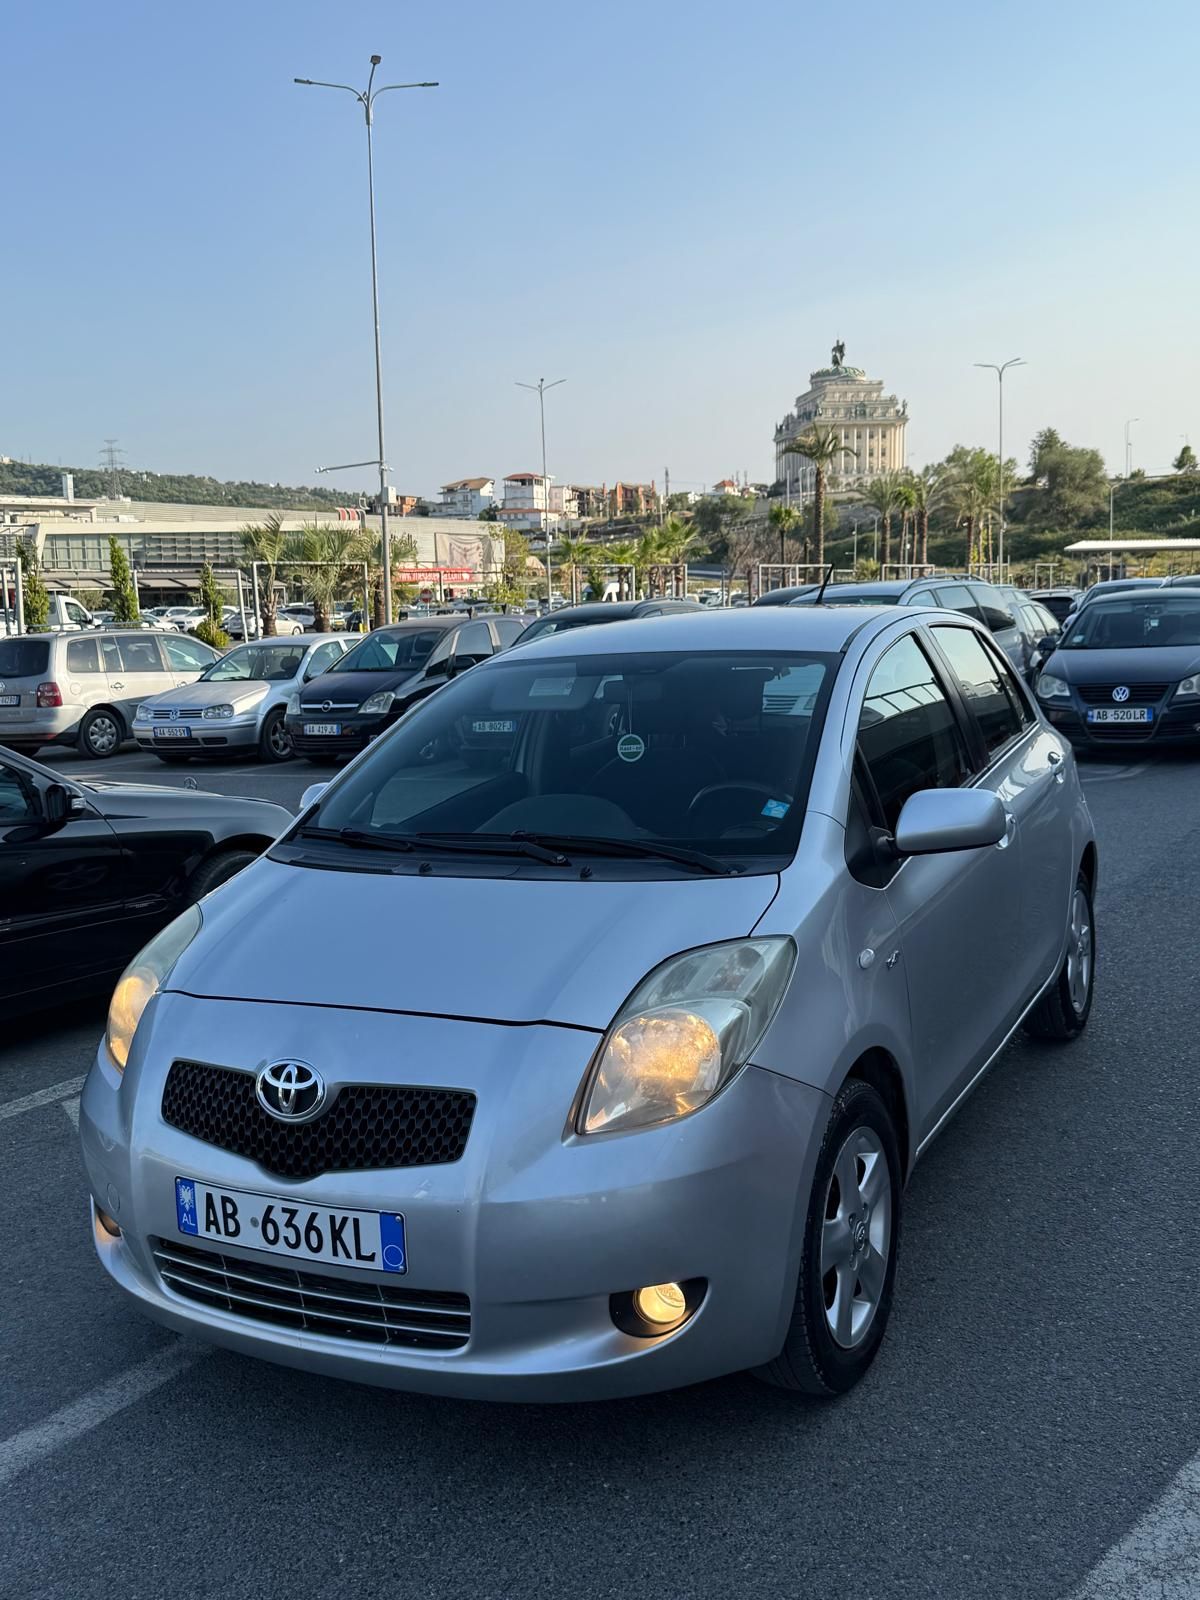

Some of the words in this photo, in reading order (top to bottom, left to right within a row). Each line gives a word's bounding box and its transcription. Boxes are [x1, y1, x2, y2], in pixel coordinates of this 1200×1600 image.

[1096, 710, 1108, 720] AB
[1113, 710, 1146, 720] 520LR
[182, 1212, 196, 1226] AL
[205, 1192, 241, 1237] AB
[261, 1205, 376, 1262] 636KL
